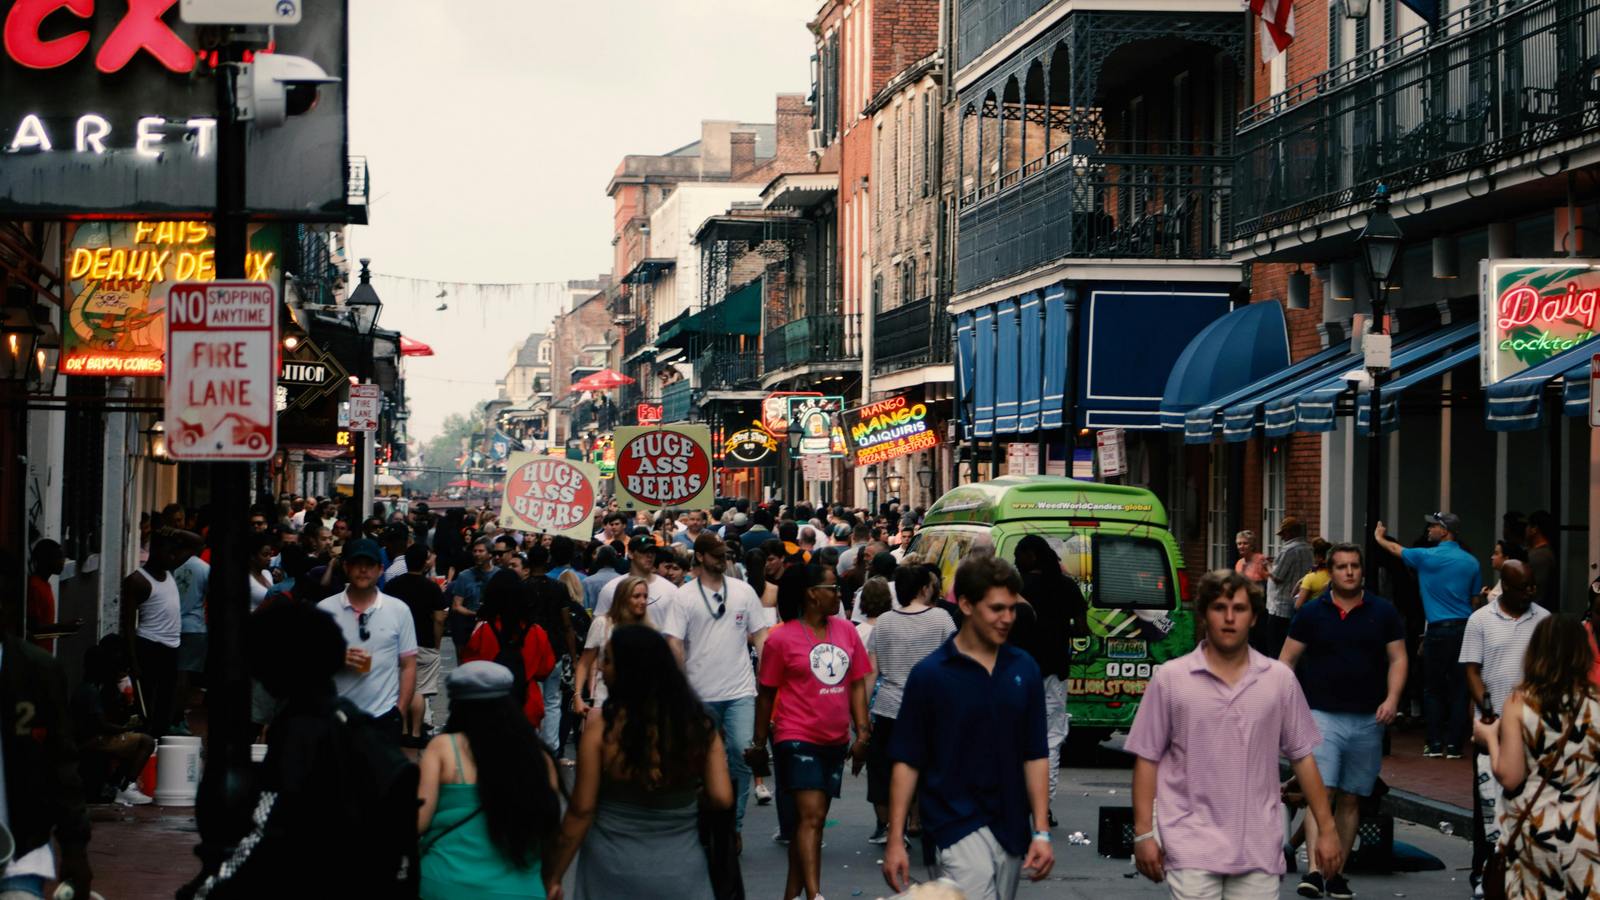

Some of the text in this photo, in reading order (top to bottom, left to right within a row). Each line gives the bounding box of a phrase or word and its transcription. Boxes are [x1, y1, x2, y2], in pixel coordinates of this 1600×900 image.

[70, 247, 274, 282] DEAUX DEX
[171, 290, 271, 324] NO STOPPING
[212, 308, 265, 323] ANYTIME
[1498, 282, 1600, 329] Daiq
[193, 342, 248, 368] FIRE
[282, 364, 325, 382] ITION
[188, 380, 252, 407] LANE
[356, 399, 371, 408] FIRE
[354, 409, 372, 418] LANE
[860, 396, 906, 419] MANGO
[852, 403, 927, 441] MANGO
[859, 420, 926, 447] DAIQUIRIS
[630, 433, 694, 459] HUGE
[908, 430, 935, 443] BEER
[523, 462, 583, 490] HUGE
[636, 456, 689, 474] ASS
[526, 482, 576, 503] ASS
[627, 473, 701, 500] BEERS
[514, 496, 584, 529] BEERS
[1012, 501, 1152, 512] www.WeedWorldCandies.global
